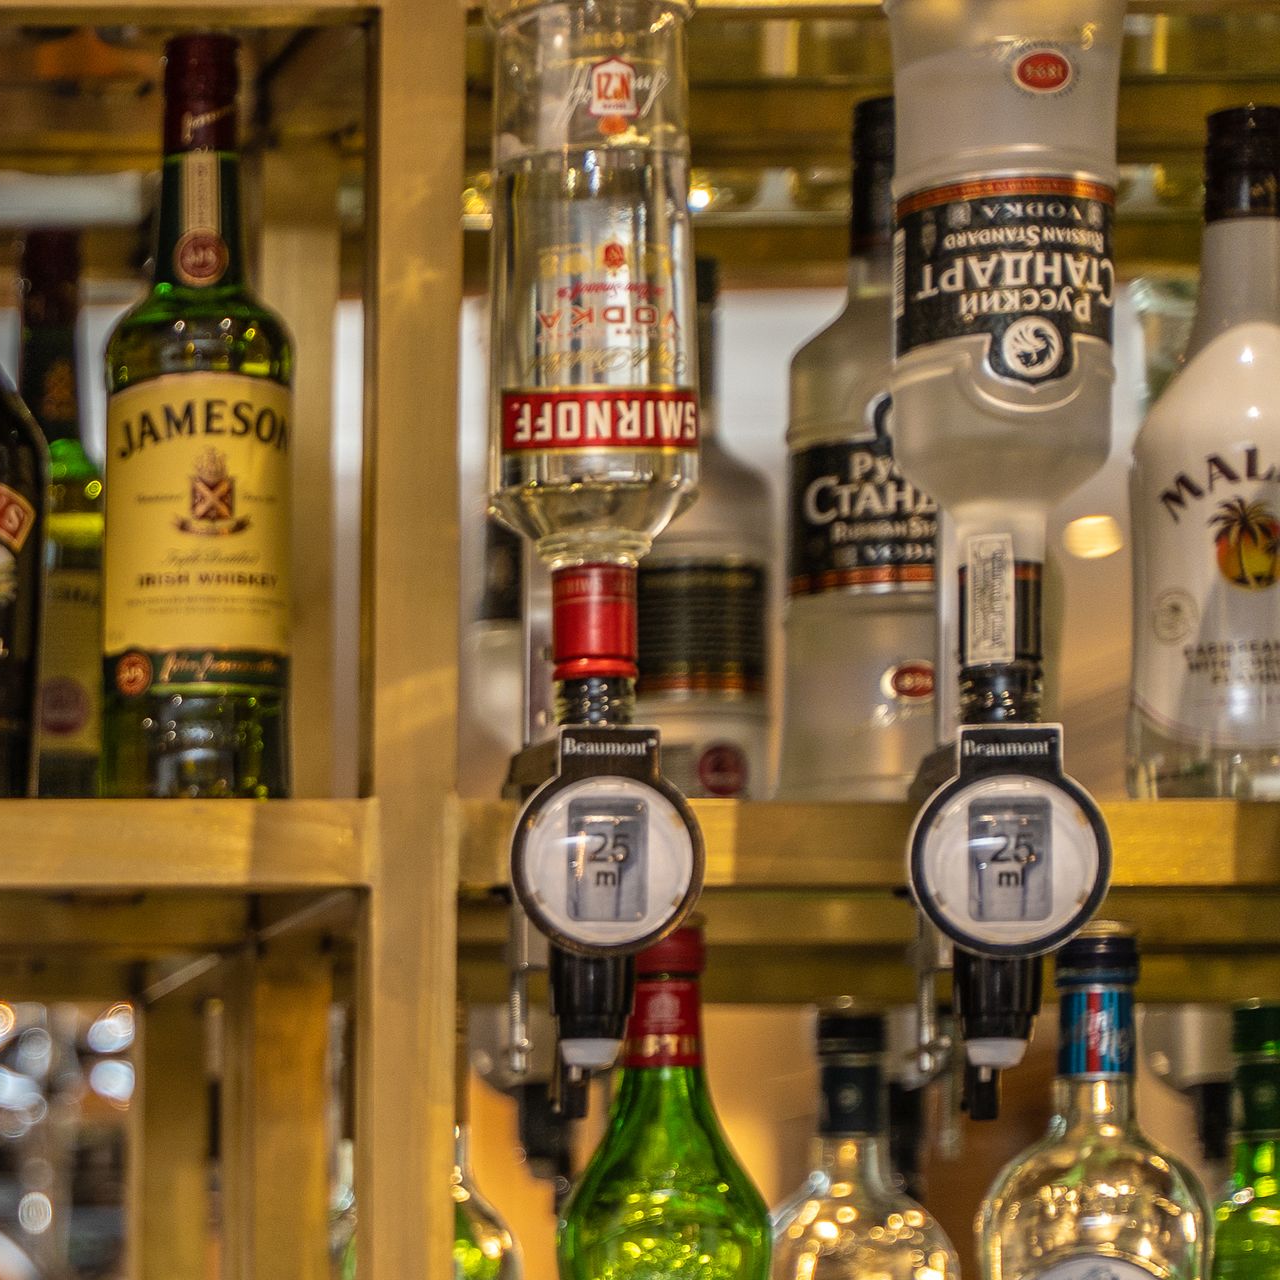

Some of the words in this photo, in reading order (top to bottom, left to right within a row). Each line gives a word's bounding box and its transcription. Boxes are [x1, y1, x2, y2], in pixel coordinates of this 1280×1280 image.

[979, 202, 1083, 221] VODKA
[535, 306, 681, 329] VODKA
[511, 398, 697, 443] SMIRNOFF
[1160, 446, 1280, 523] MAL
[561, 736, 650, 757] Beaumont
[962, 738, 1052, 758] Beaumont
[588, 832, 630, 864] 25
[990, 833, 1035, 864] 25
[594, 865, 623, 888] ml
[996, 866, 1026, 889] ml
